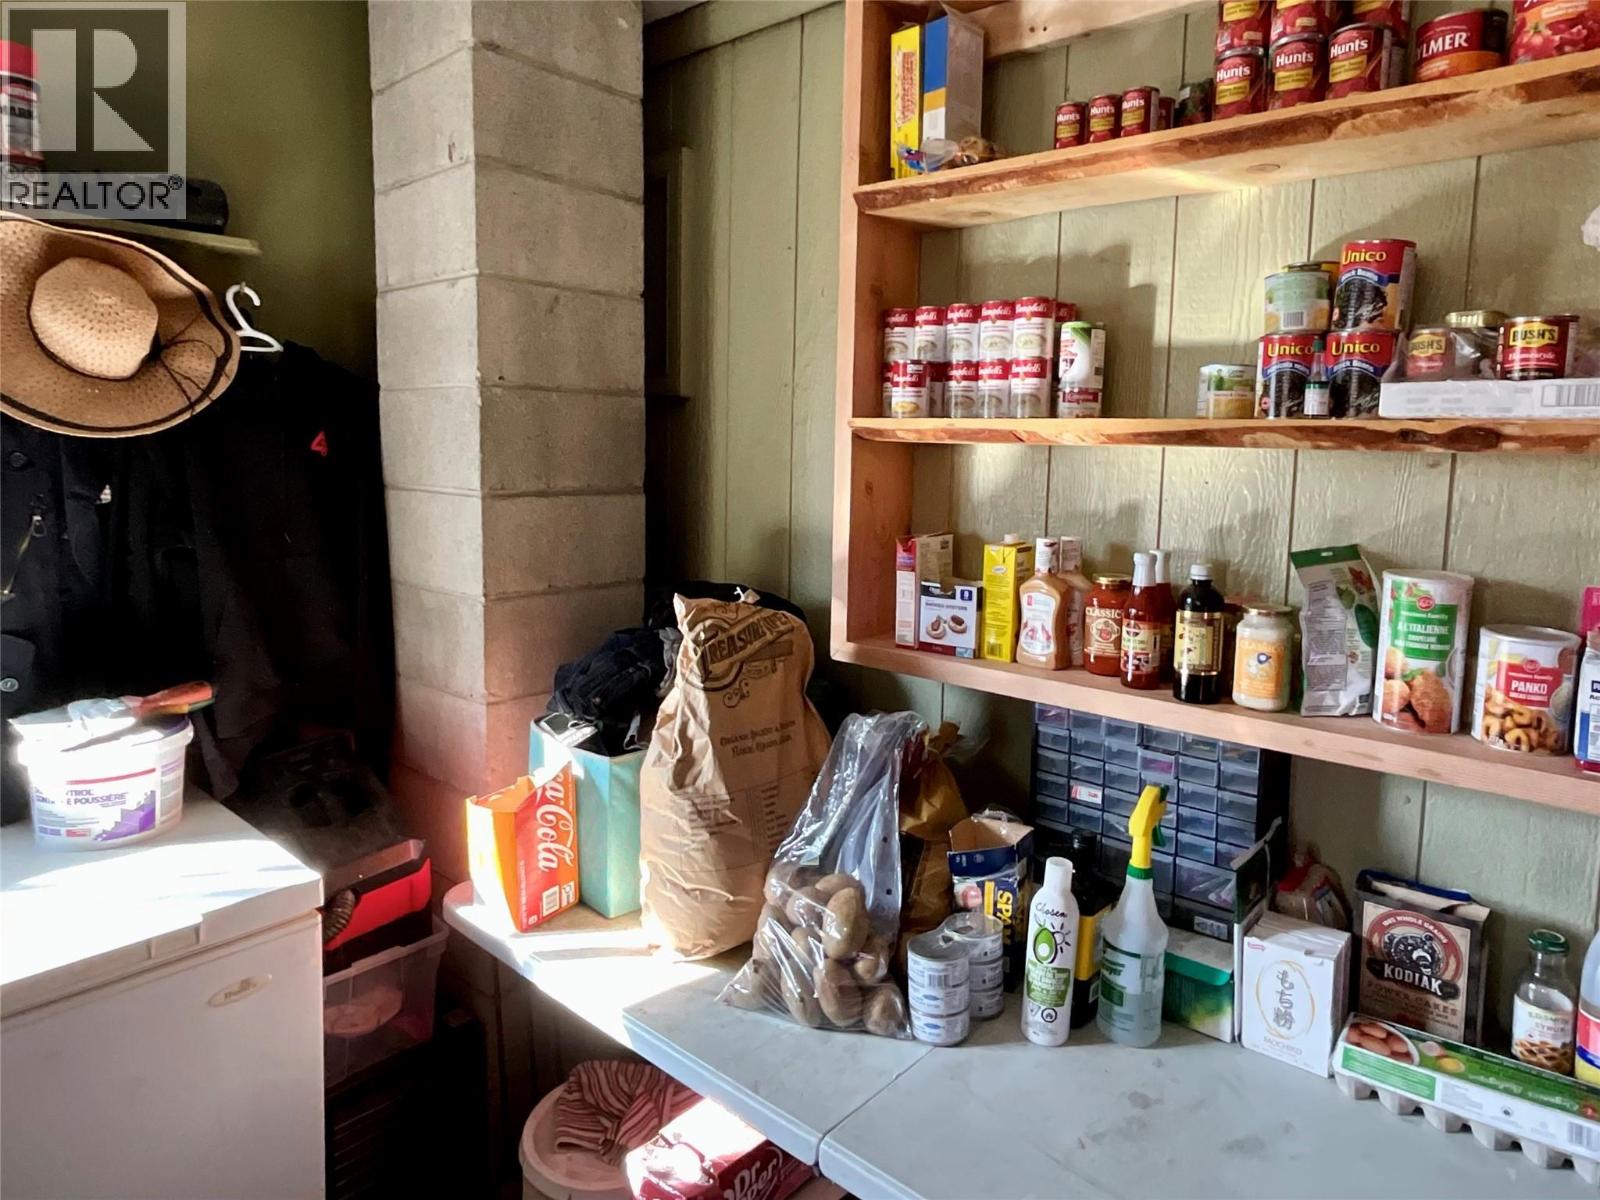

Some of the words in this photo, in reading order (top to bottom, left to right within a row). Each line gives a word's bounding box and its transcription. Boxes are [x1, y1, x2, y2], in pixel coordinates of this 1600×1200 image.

[1416, 31, 1469, 61] YLMER
[1341, 248, 1387, 265] Unico
[1512, 328, 1556, 342] BUSH'S
[1267, 341, 1313, 357] Unico
[1331, 340, 1380, 356] Unico
[1085, 607, 1124, 620] CLASSIC
[1511, 680, 1548, 695] PANKO
[1384, 962, 1443, 996] KODIAK
